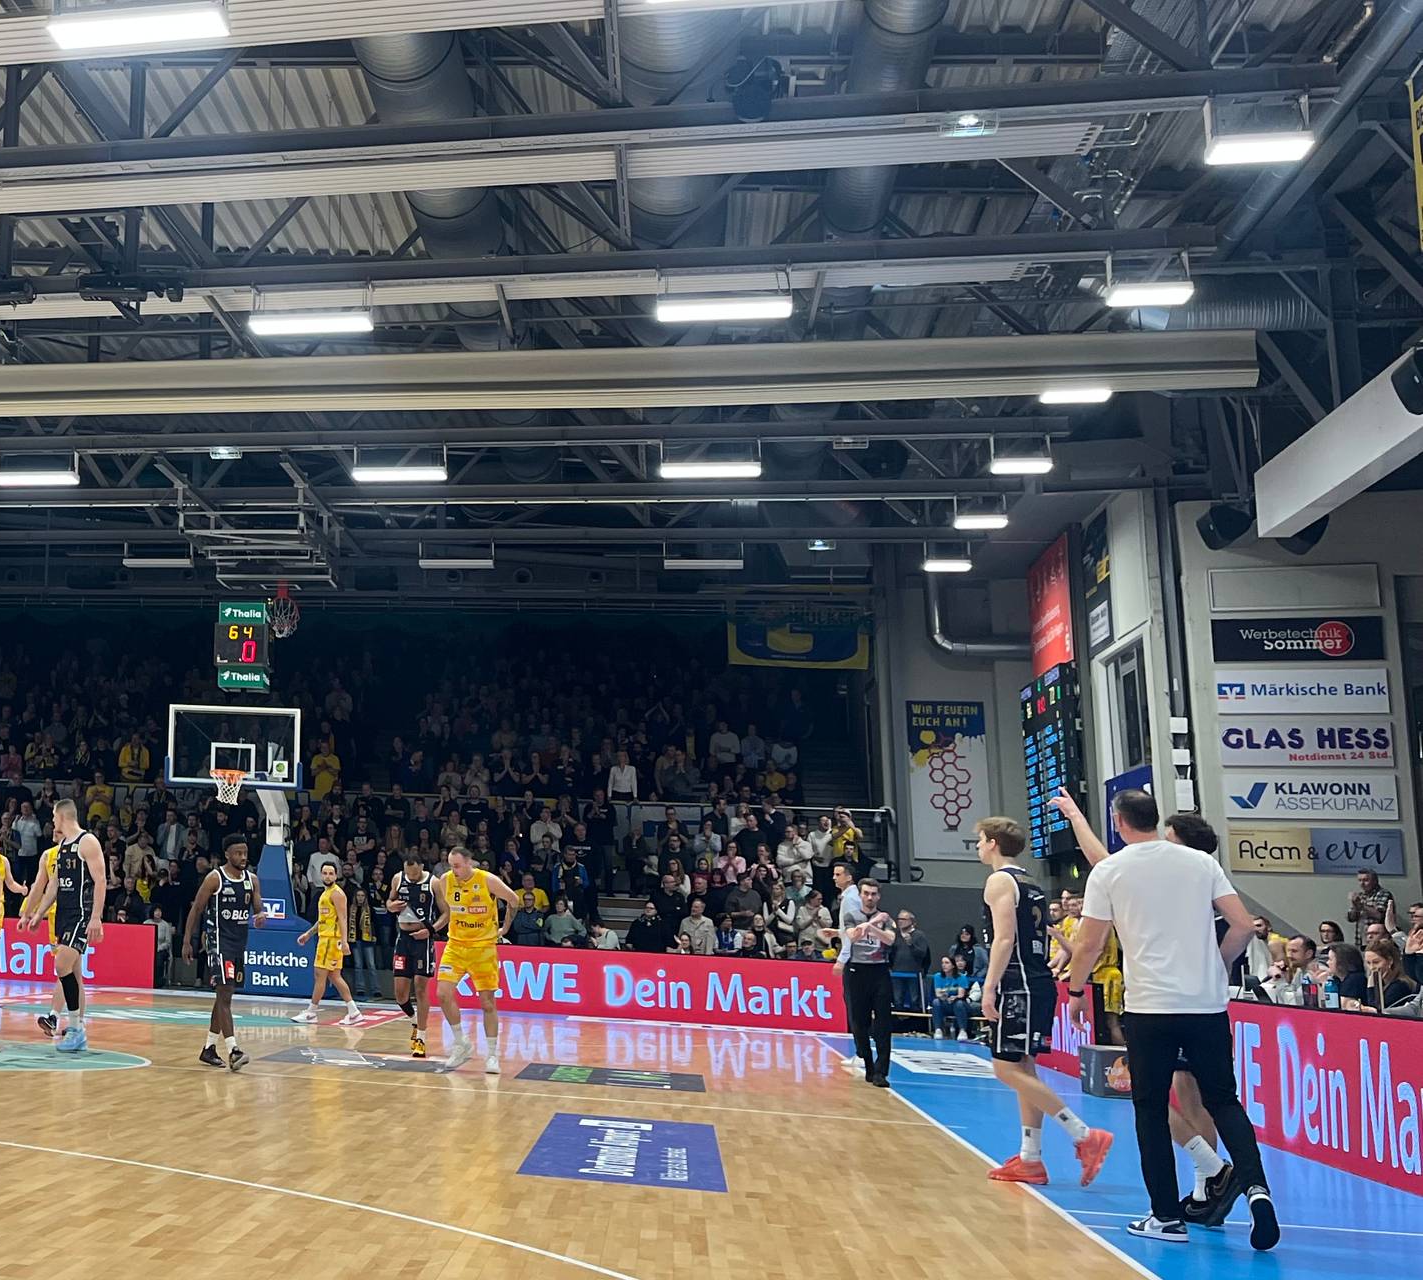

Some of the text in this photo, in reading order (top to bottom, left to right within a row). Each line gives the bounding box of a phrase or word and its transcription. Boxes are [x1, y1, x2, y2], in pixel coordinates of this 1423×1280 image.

[232, 609, 262, 618] Thalia
[1239, 628, 1342, 640] Werbetechnik
[1264, 639, 1343, 650] Sommer
[231, 672, 261, 682] Thalia
[1251, 682, 1386, 696] Märkische Bank
[912, 717, 940, 726] EUCH
[1222, 728, 1390, 749] GLAS HESS
[1289, 751, 1392, 762] Notdienst 24 Std.
[1274, 783, 1371, 795] KLAWONN
[1275, 797, 1395, 811] ASSEKURANZ
[1239, 840, 1390, 865] Adam & eva
[65, 859, 76, 869] 31
[454, 891, 461, 902] 8
[231, 909, 249, 920] BLG
[243, 950, 308, 967] ärkische
[252, 971, 289, 987] Bank
[455, 960, 833, 1020] WE Dein Markt
[1277, 1022, 1350, 1153] Dein
[1360, 1038, 1423, 1175] Ma
